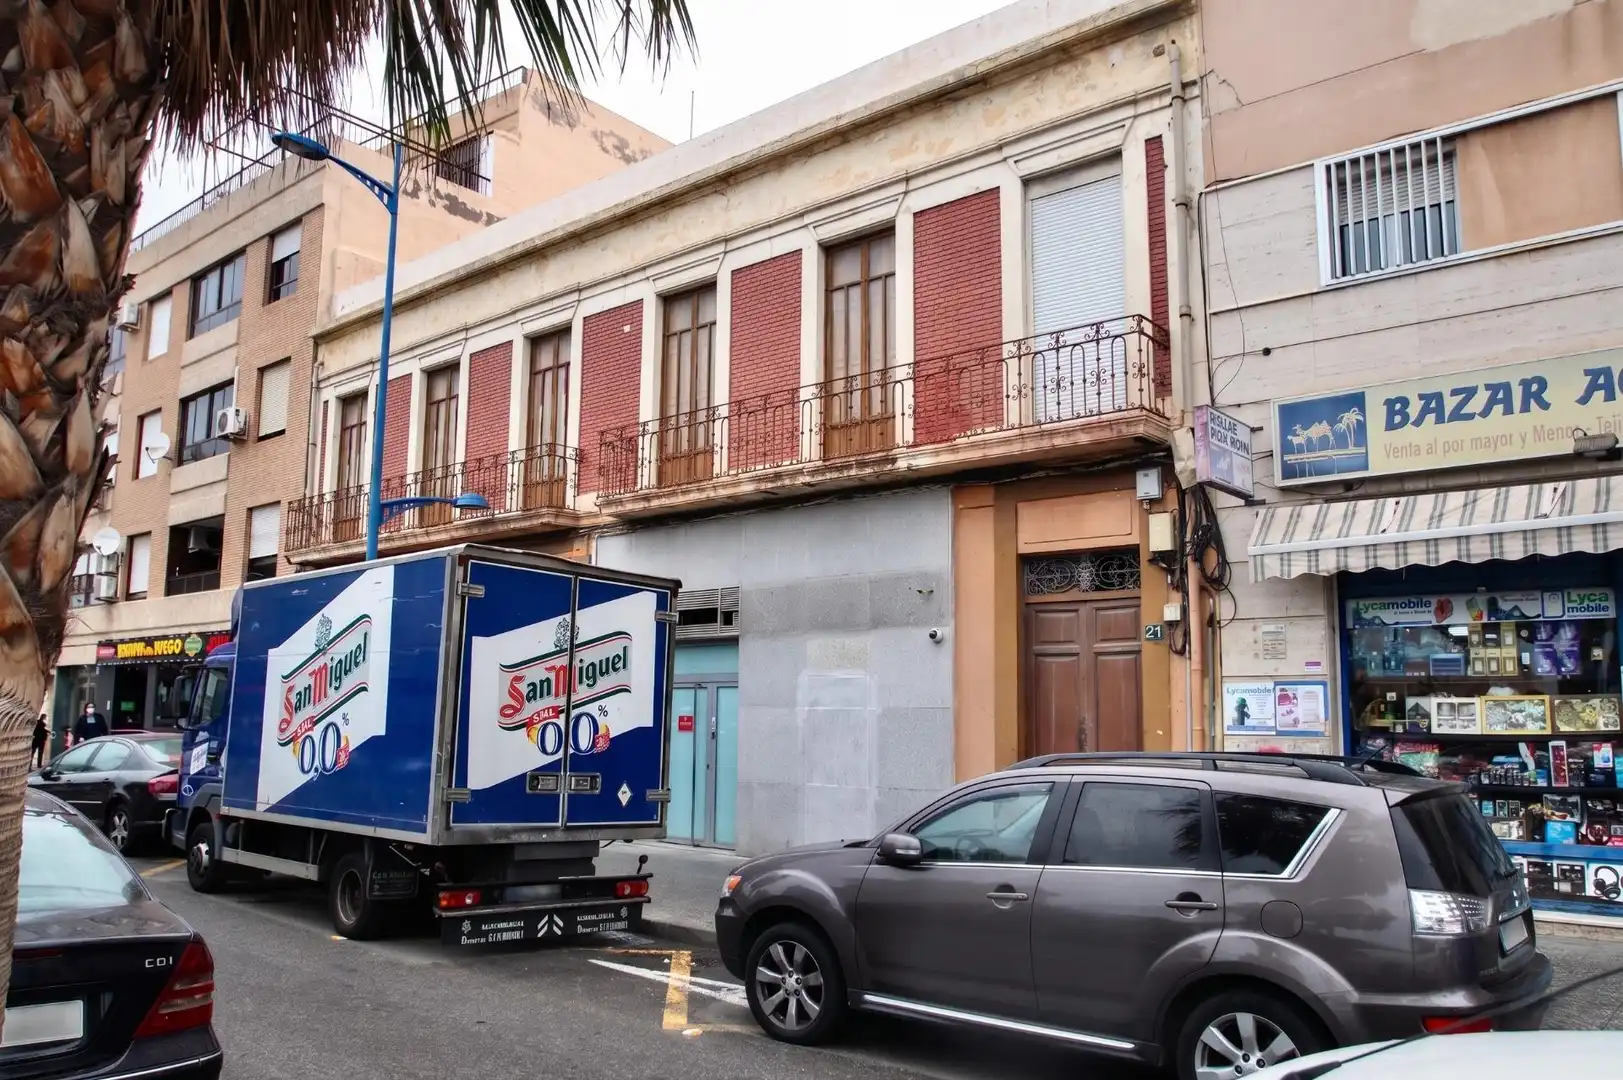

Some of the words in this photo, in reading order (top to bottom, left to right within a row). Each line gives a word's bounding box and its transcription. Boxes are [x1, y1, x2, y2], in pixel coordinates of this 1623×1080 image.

[1383, 375, 1552, 432] BAZAR
[1575, 365, 1623, 405] A
[1384, 442, 1421, 460] Venta
[1426, 437, 1438, 456] al
[1443, 438, 1464, 459] por
[1470, 433, 1513, 455] mayor
[1519, 431, 1528, 449] y
[1567, 591, 1609, 605] Lyca
[1356, 598, 1432, 614] Lycamobile
[1567, 603, 1609, 613] mobile
[1145, 625, 1162, 638] 21
[279, 683, 312, 733] San
[308, 631, 367, 707] Miguel
[500, 675, 551, 719] San
[545, 645, 628, 699] Miguel
[1226, 687, 1272, 696] Lycamobile
[145, 956, 173, 968] CDI
